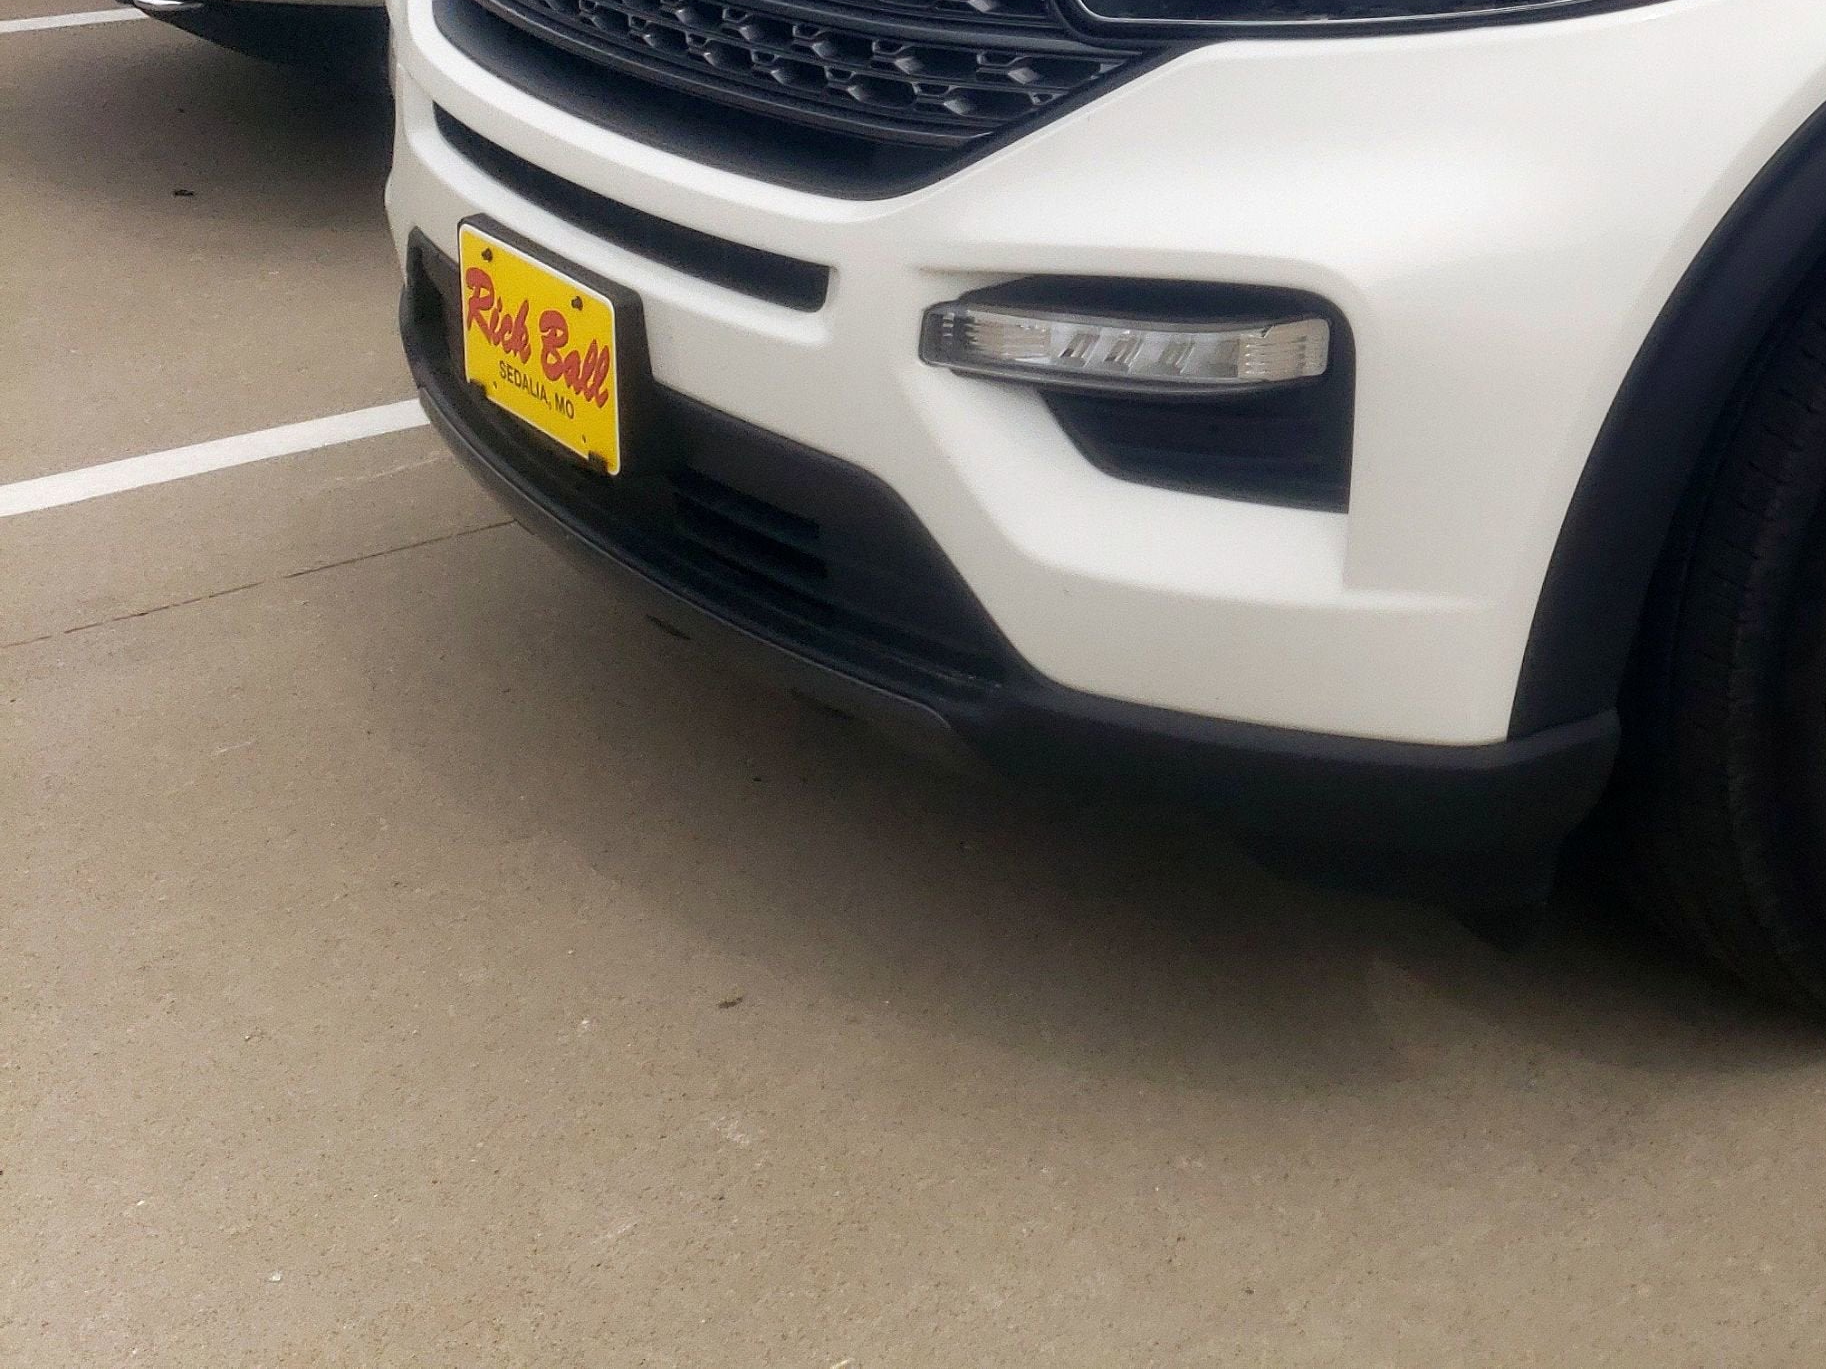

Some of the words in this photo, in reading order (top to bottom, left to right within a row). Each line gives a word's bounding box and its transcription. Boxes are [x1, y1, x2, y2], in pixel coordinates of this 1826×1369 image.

[499, 359, 552, 411] SEDALIA,
[554, 392, 575, 420] MO
[538, 309, 611, 409] Ball
